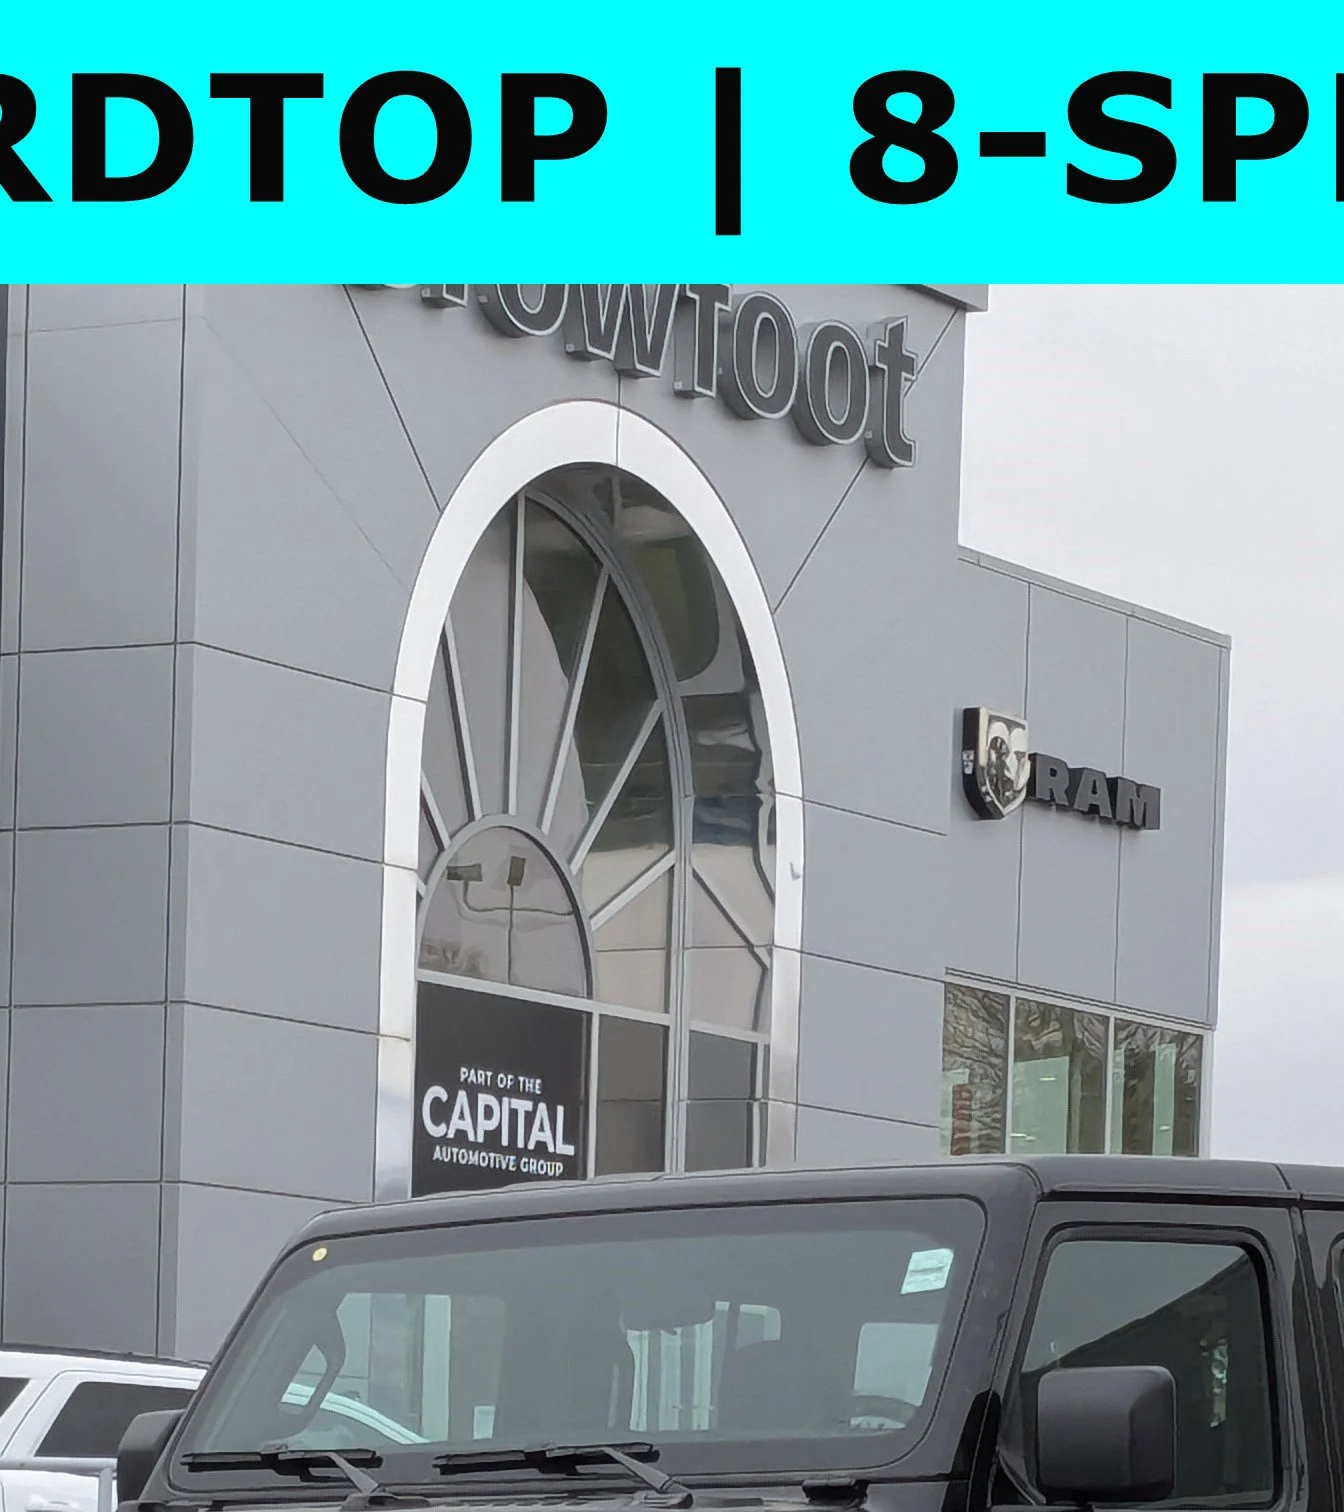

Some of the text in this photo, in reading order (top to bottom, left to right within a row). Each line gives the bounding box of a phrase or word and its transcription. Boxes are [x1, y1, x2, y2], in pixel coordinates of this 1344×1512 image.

[1029, 752, 1162, 831] RAM
[459, 1066, 543, 1095] PART OF THE
[421, 1084, 576, 1157] CAPITAL
[432, 1144, 565, 1177] AUTOMOTIVE GROUP
